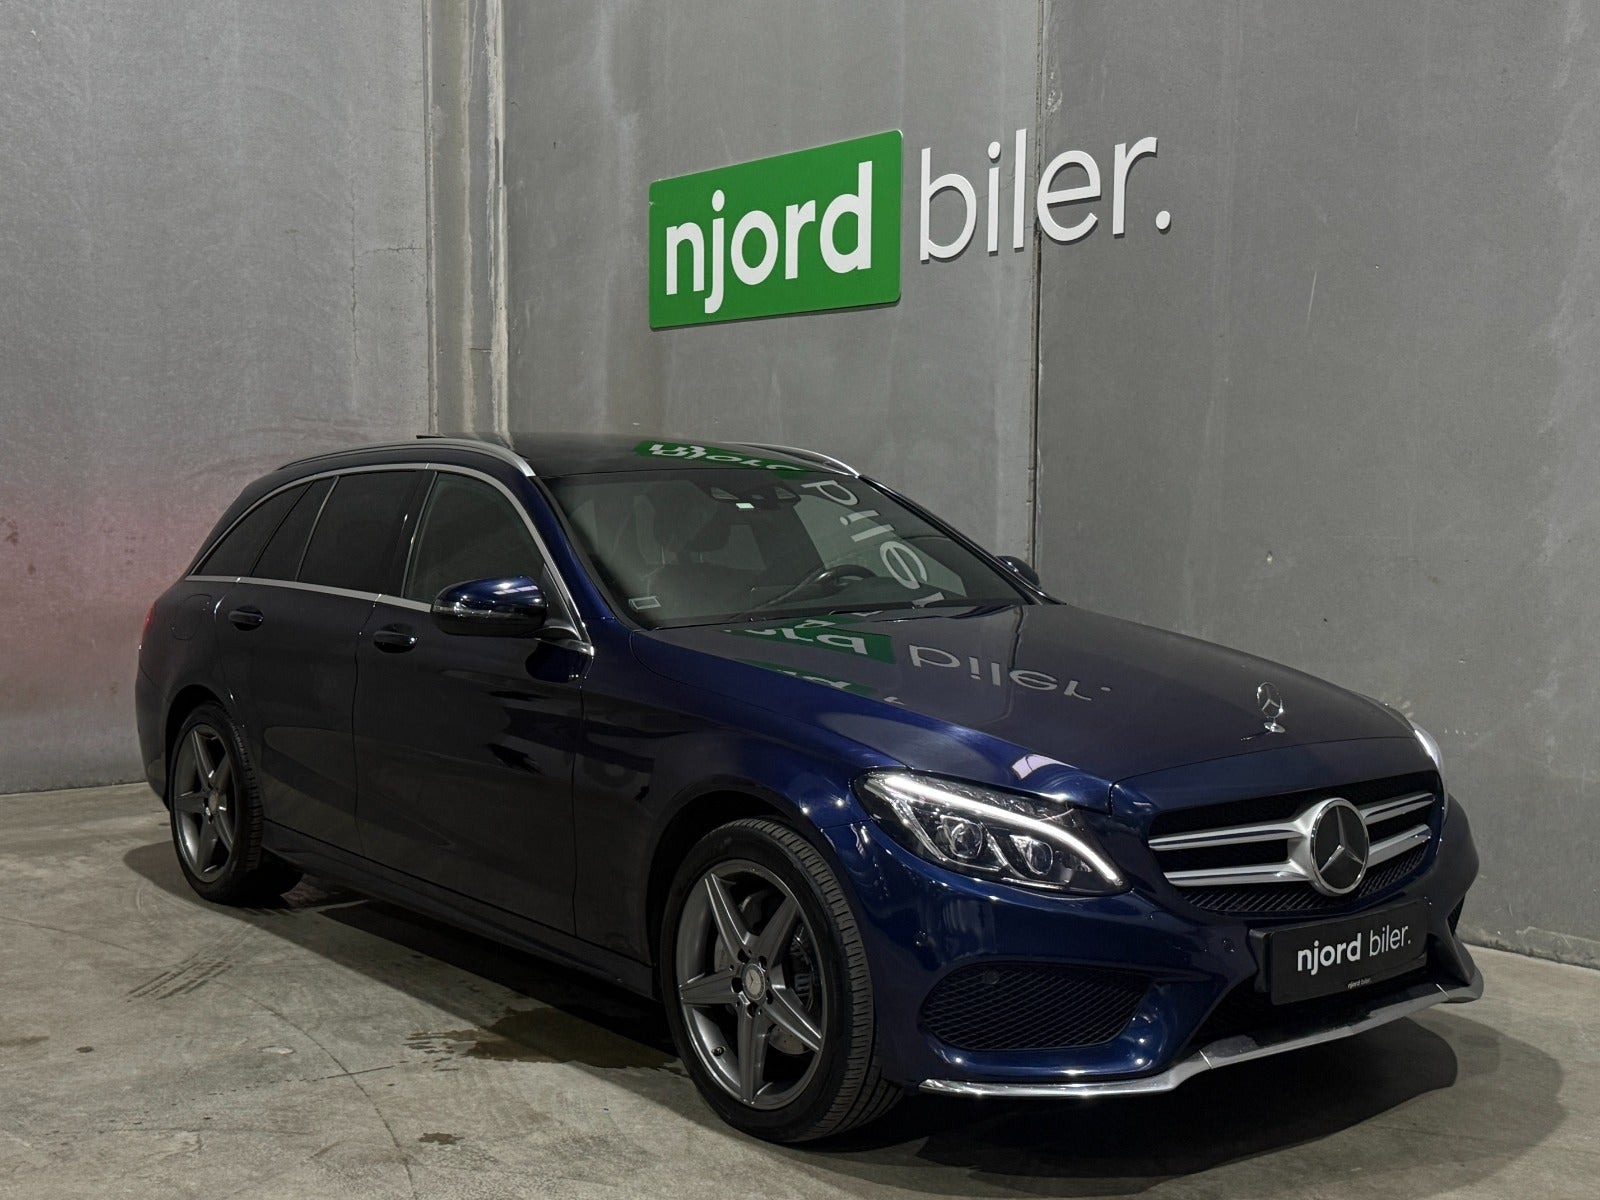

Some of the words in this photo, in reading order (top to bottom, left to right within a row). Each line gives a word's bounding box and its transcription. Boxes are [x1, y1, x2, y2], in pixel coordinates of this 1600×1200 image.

[666, 160, 873, 314] njord
[920, 128, 1172, 262] biler.
[1297, 932, 1361, 976] njord
[1369, 924, 1412, 957] biler.
